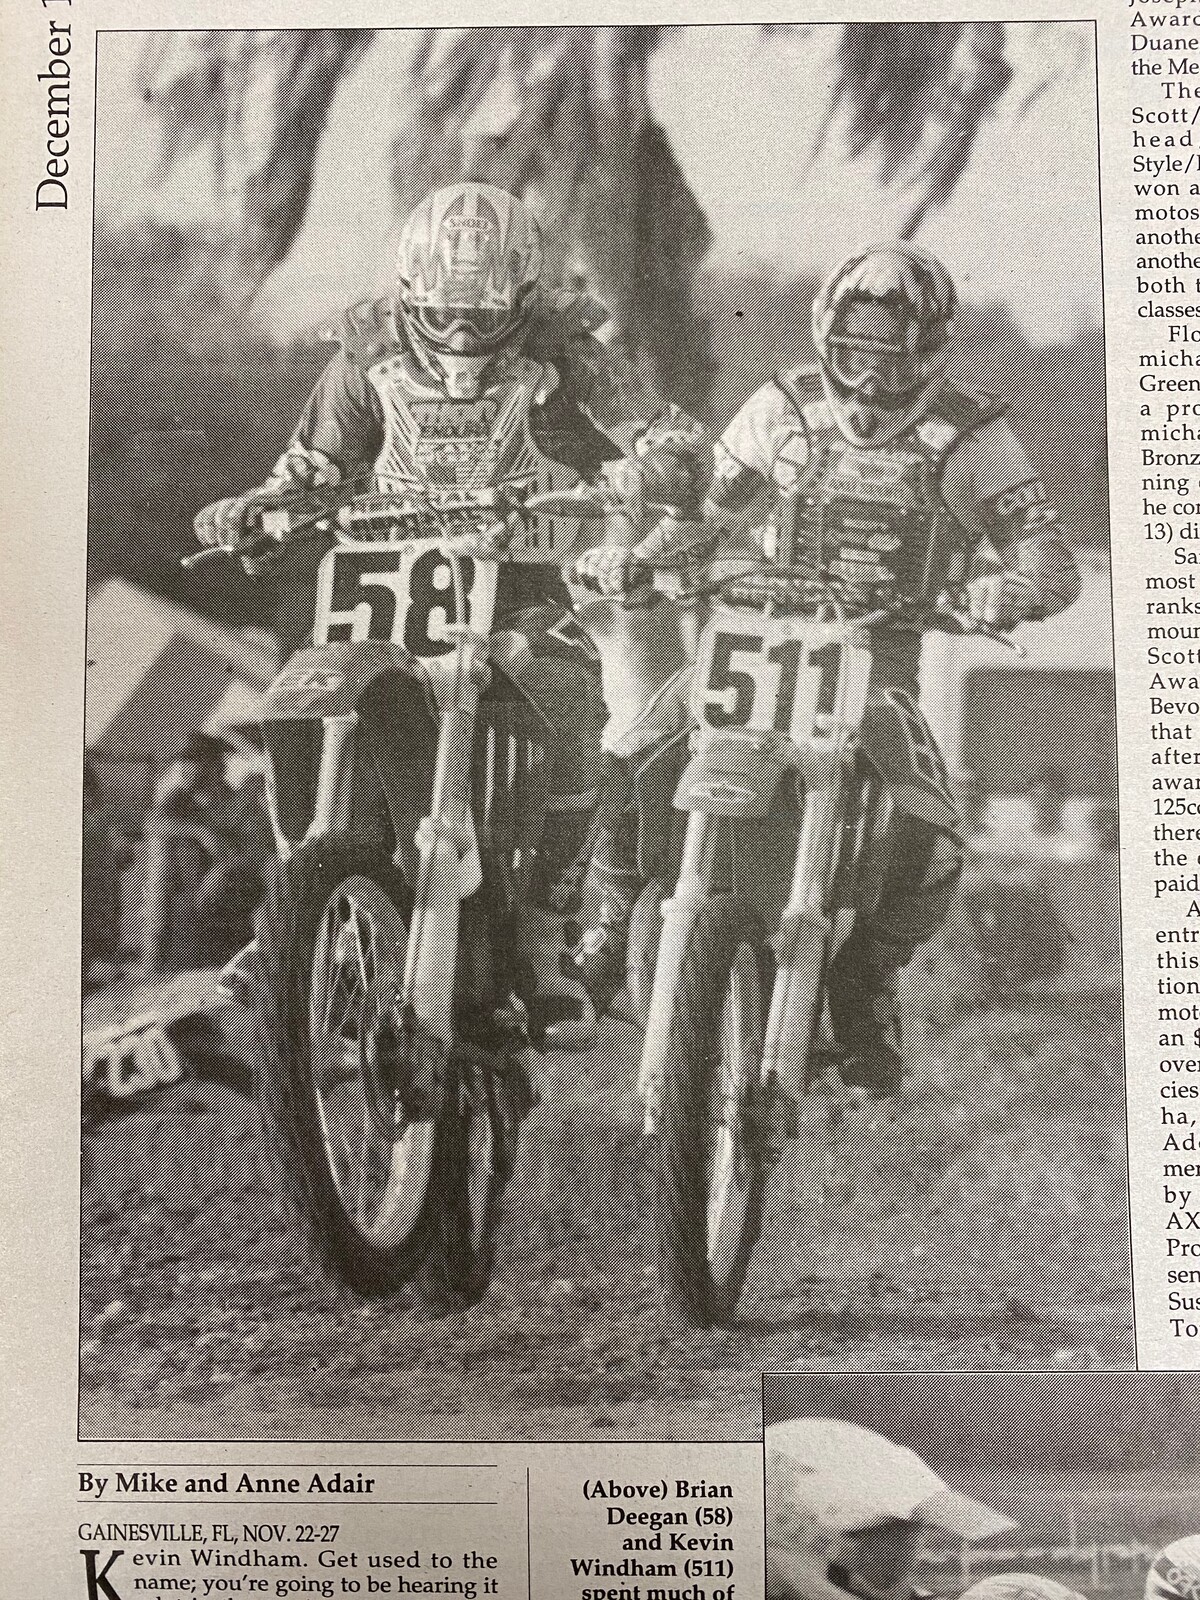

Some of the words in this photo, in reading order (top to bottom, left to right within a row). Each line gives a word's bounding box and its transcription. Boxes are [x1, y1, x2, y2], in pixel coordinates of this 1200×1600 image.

[1131, 35, 1198, 52] Duane
[1131, 58, 1161, 75] the
[1161, 82, 1200, 99] The
[36, 21, 71, 211] December
[1133, 130, 1193, 147] head
[1134, 154, 1200, 177] Style/
[1134, 184, 1180, 196] won
[1135, 206, 1199, 220] motos
[1136, 276, 1185, 293] both
[1140, 375, 1200, 392] Green
[1140, 405, 1151, 416] a
[1141, 449, 1200, 466] Bronz
[1142, 474, 1189, 496] ning
[1143, 498, 1166, 515] he
[1144, 523, 1173, 544] 13)
[1175, 547, 1198, 564] Sa
[1146, 574, 1195, 589] most
[326, 549, 476, 658] 58
[703, 631, 843, 737] 511
[1149, 673, 1199, 689] Awa
[1150, 698, 1199, 714] Bevo
[1151, 722, 1192, 740] that
[1154, 849, 1187, 866] the
[1154, 874, 1200, 898] paid
[1156, 927, 1199, 943] entr
[1157, 951, 1198, 969] this
[1157, 977, 1200, 994] tion
[1158, 1005, 1199, 1020] mot
[1159, 1034, 1184, 1046] an
[1161, 1081, 1199, 1098] cies
[1161, 1107, 1196, 1127] ha,
[1163, 1133, 1200, 1150] Ad
[1163, 1185, 1191, 1209] by
[1165, 1212, 1200, 1229] AX
[1168, 1271, 1200, 1283] sen
[78, 1473, 108, 1498] By
[115, 1472, 177, 1492] Mike
[185, 1473, 228, 1492] and
[236, 1473, 299, 1493] Anne
[307, 1473, 375, 1493] Adair
[583, 1480, 667, 1500] (Above)
[675, 1480, 733, 1498] Brian
[607, 1507, 688, 1530] Deegan
[696, 1507, 733, 1527] (58)
[78, 1523, 207, 1544] GAINESVILLE,
[212, 1525, 238, 1545] FL,
[243, 1525, 290, 1542] NOV.
[296, 1525, 339, 1542] 22-27
[623, 1533, 662, 1550] and
[669, 1533, 734, 1551] Kevin
[191, 1549, 307, 1567] Windham.
[318, 1550, 357, 1567] Get
[368, 1551, 421, 1568] used
[431, 1553, 452, 1568] to
[463, 1551, 497, 1568] the
[570, 1559, 677, 1576] Windham
[684, 1559, 733, 1578] (511)
[134, 1578, 196, 1593] name;
[203, 1575, 268, 1596] you're
[276, 1576, 334, 1598] going
[341, 1578, 360, 1592] to
[367, 1575, 391, 1593] be
[398, 1576, 477, 1599] hearing
[484, 1577, 498, 1593] it
[582, 1586, 640, 1600] spent
[647, 1584, 705, 1600] much
